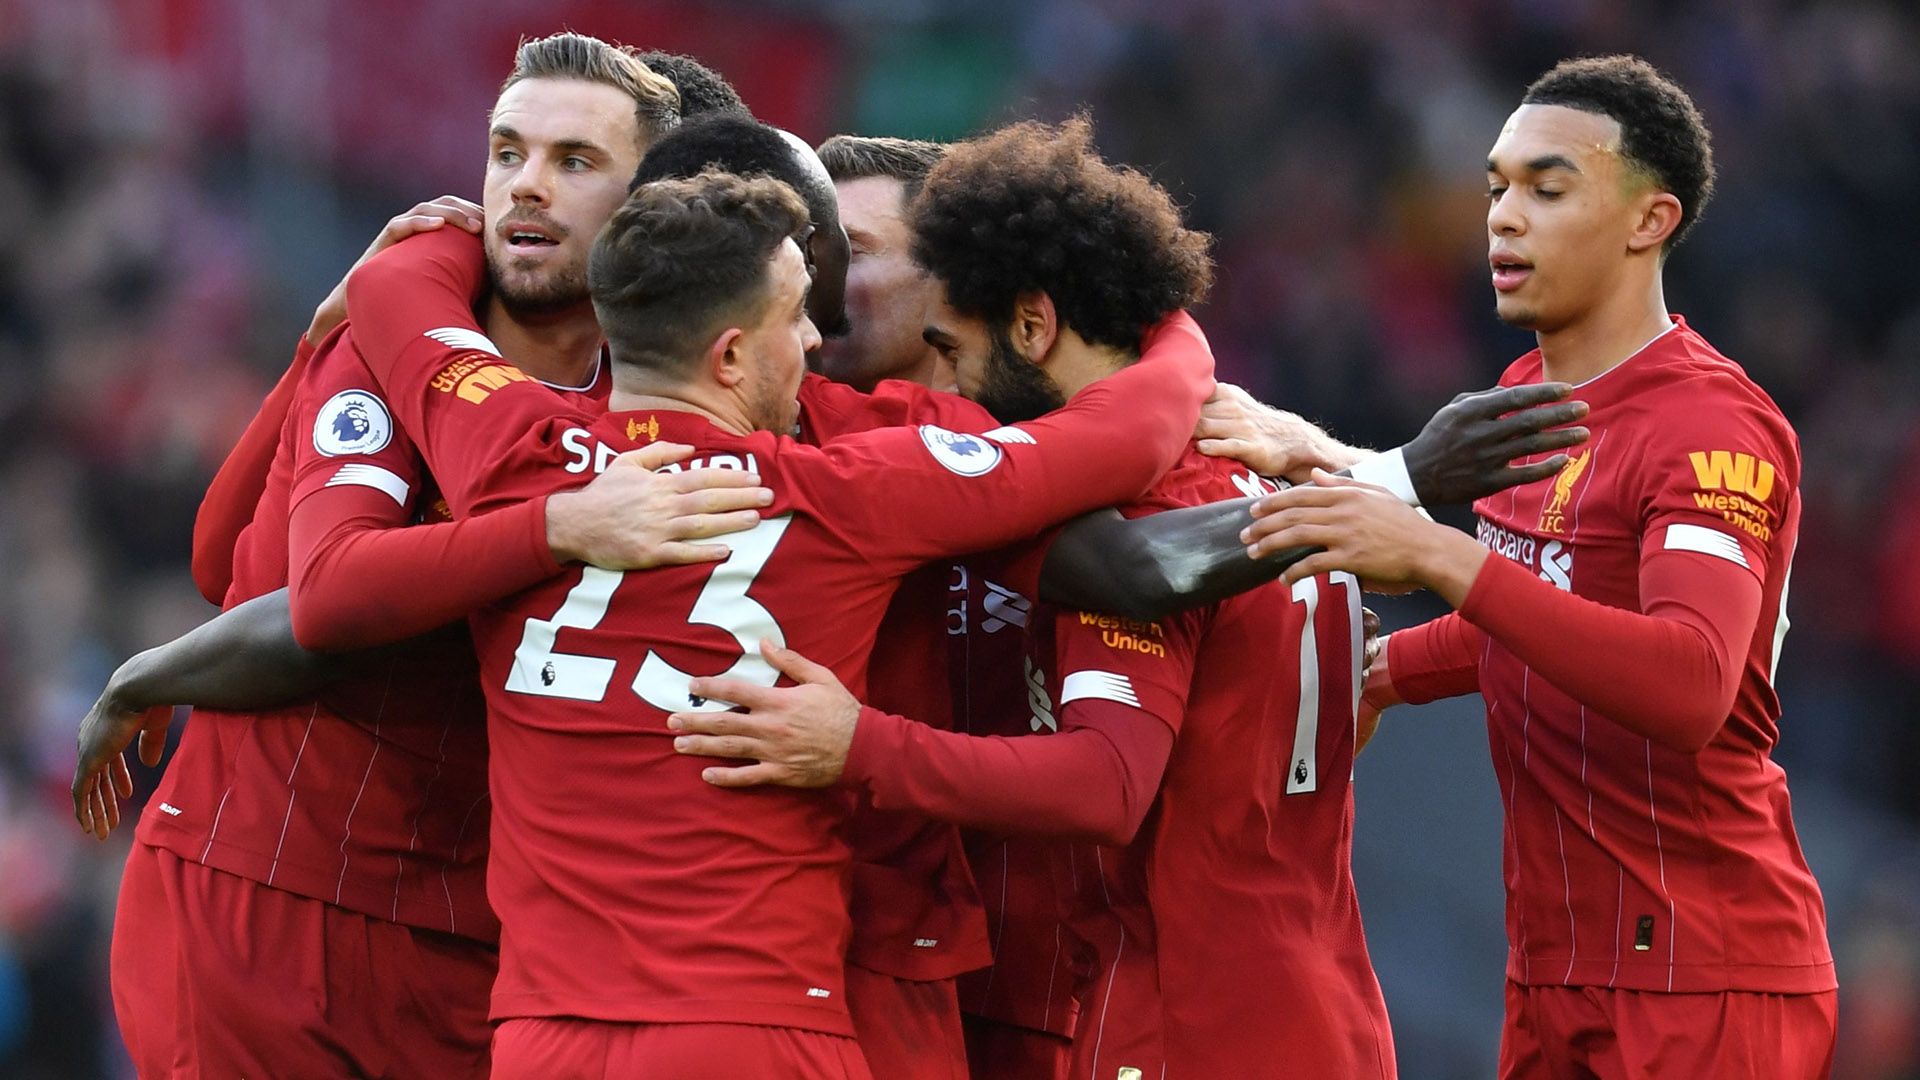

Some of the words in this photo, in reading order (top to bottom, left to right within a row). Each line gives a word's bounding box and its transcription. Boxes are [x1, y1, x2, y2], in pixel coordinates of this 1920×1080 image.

[1688, 450, 1775, 502] WU
[1723, 511, 1769, 542] Union
[504, 511, 794, 714] 23
[1102, 631, 1165, 658] Union
[1286, 570, 1364, 796] 11
